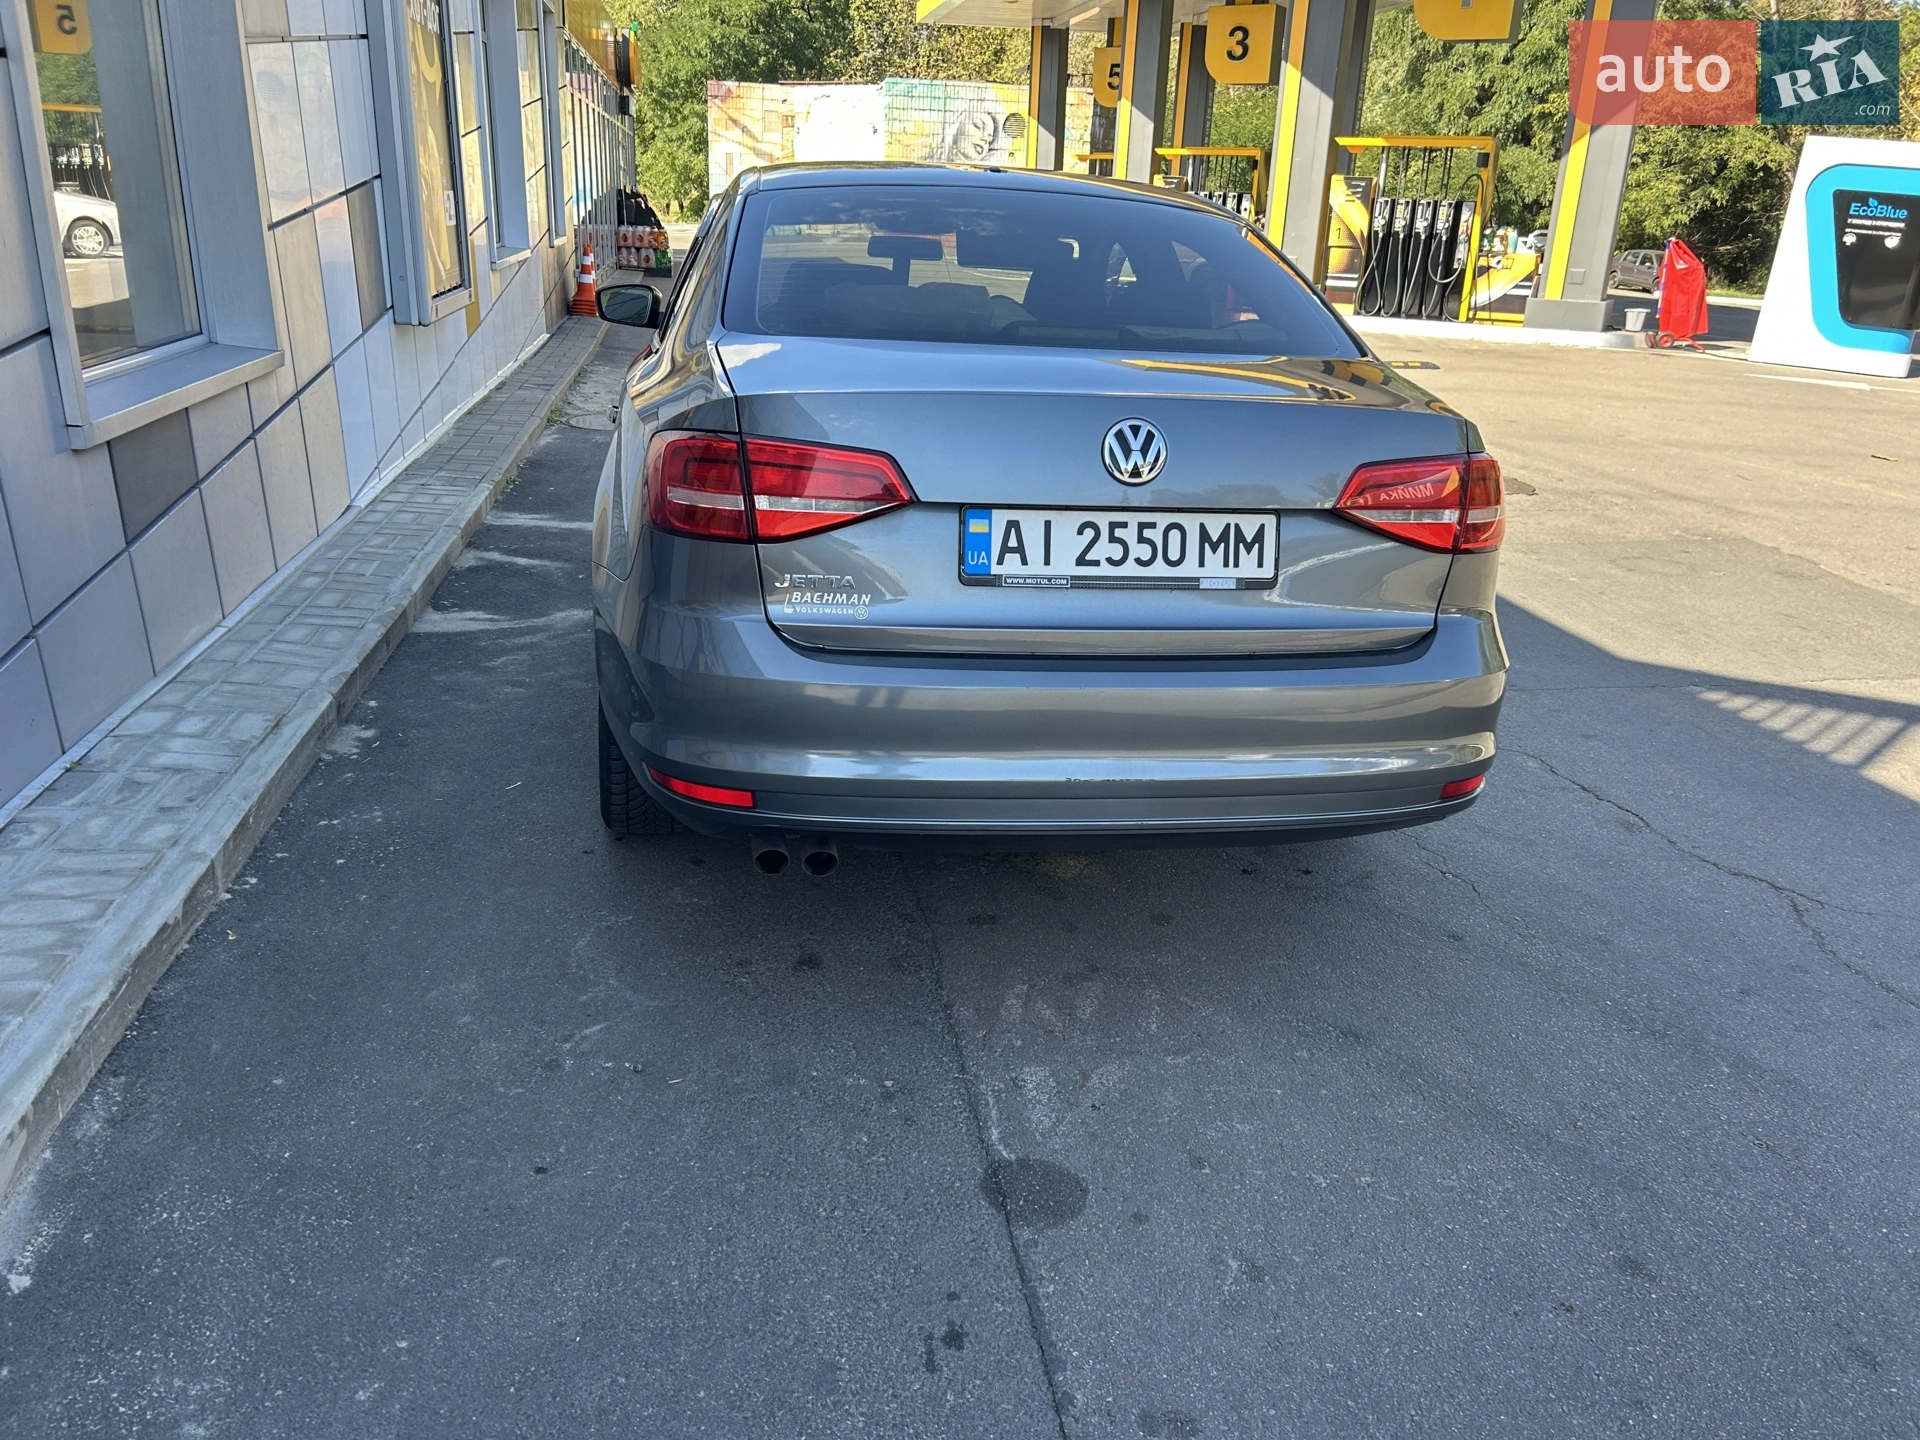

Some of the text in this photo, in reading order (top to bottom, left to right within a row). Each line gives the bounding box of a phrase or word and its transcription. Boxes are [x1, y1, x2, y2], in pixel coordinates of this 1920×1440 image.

[1226, 25, 1249, 62] 3
[1107, 63, 1121, 91] 5
[1848, 202, 1908, 219] EcoBlue
[1335, 227, 1342, 240] 1
[1074, 520, 1188, 568] 2550
[1197, 522, 1267, 569] MM
[967, 550, 989, 566] UA
[774, 573, 857, 590] JETTA
[1005, 576, 1068, 586] WWW.MOTUL.COM
[791, 591, 871, 605] BACHMAN
[795, 606, 854, 615] VOLKSWAGEN
